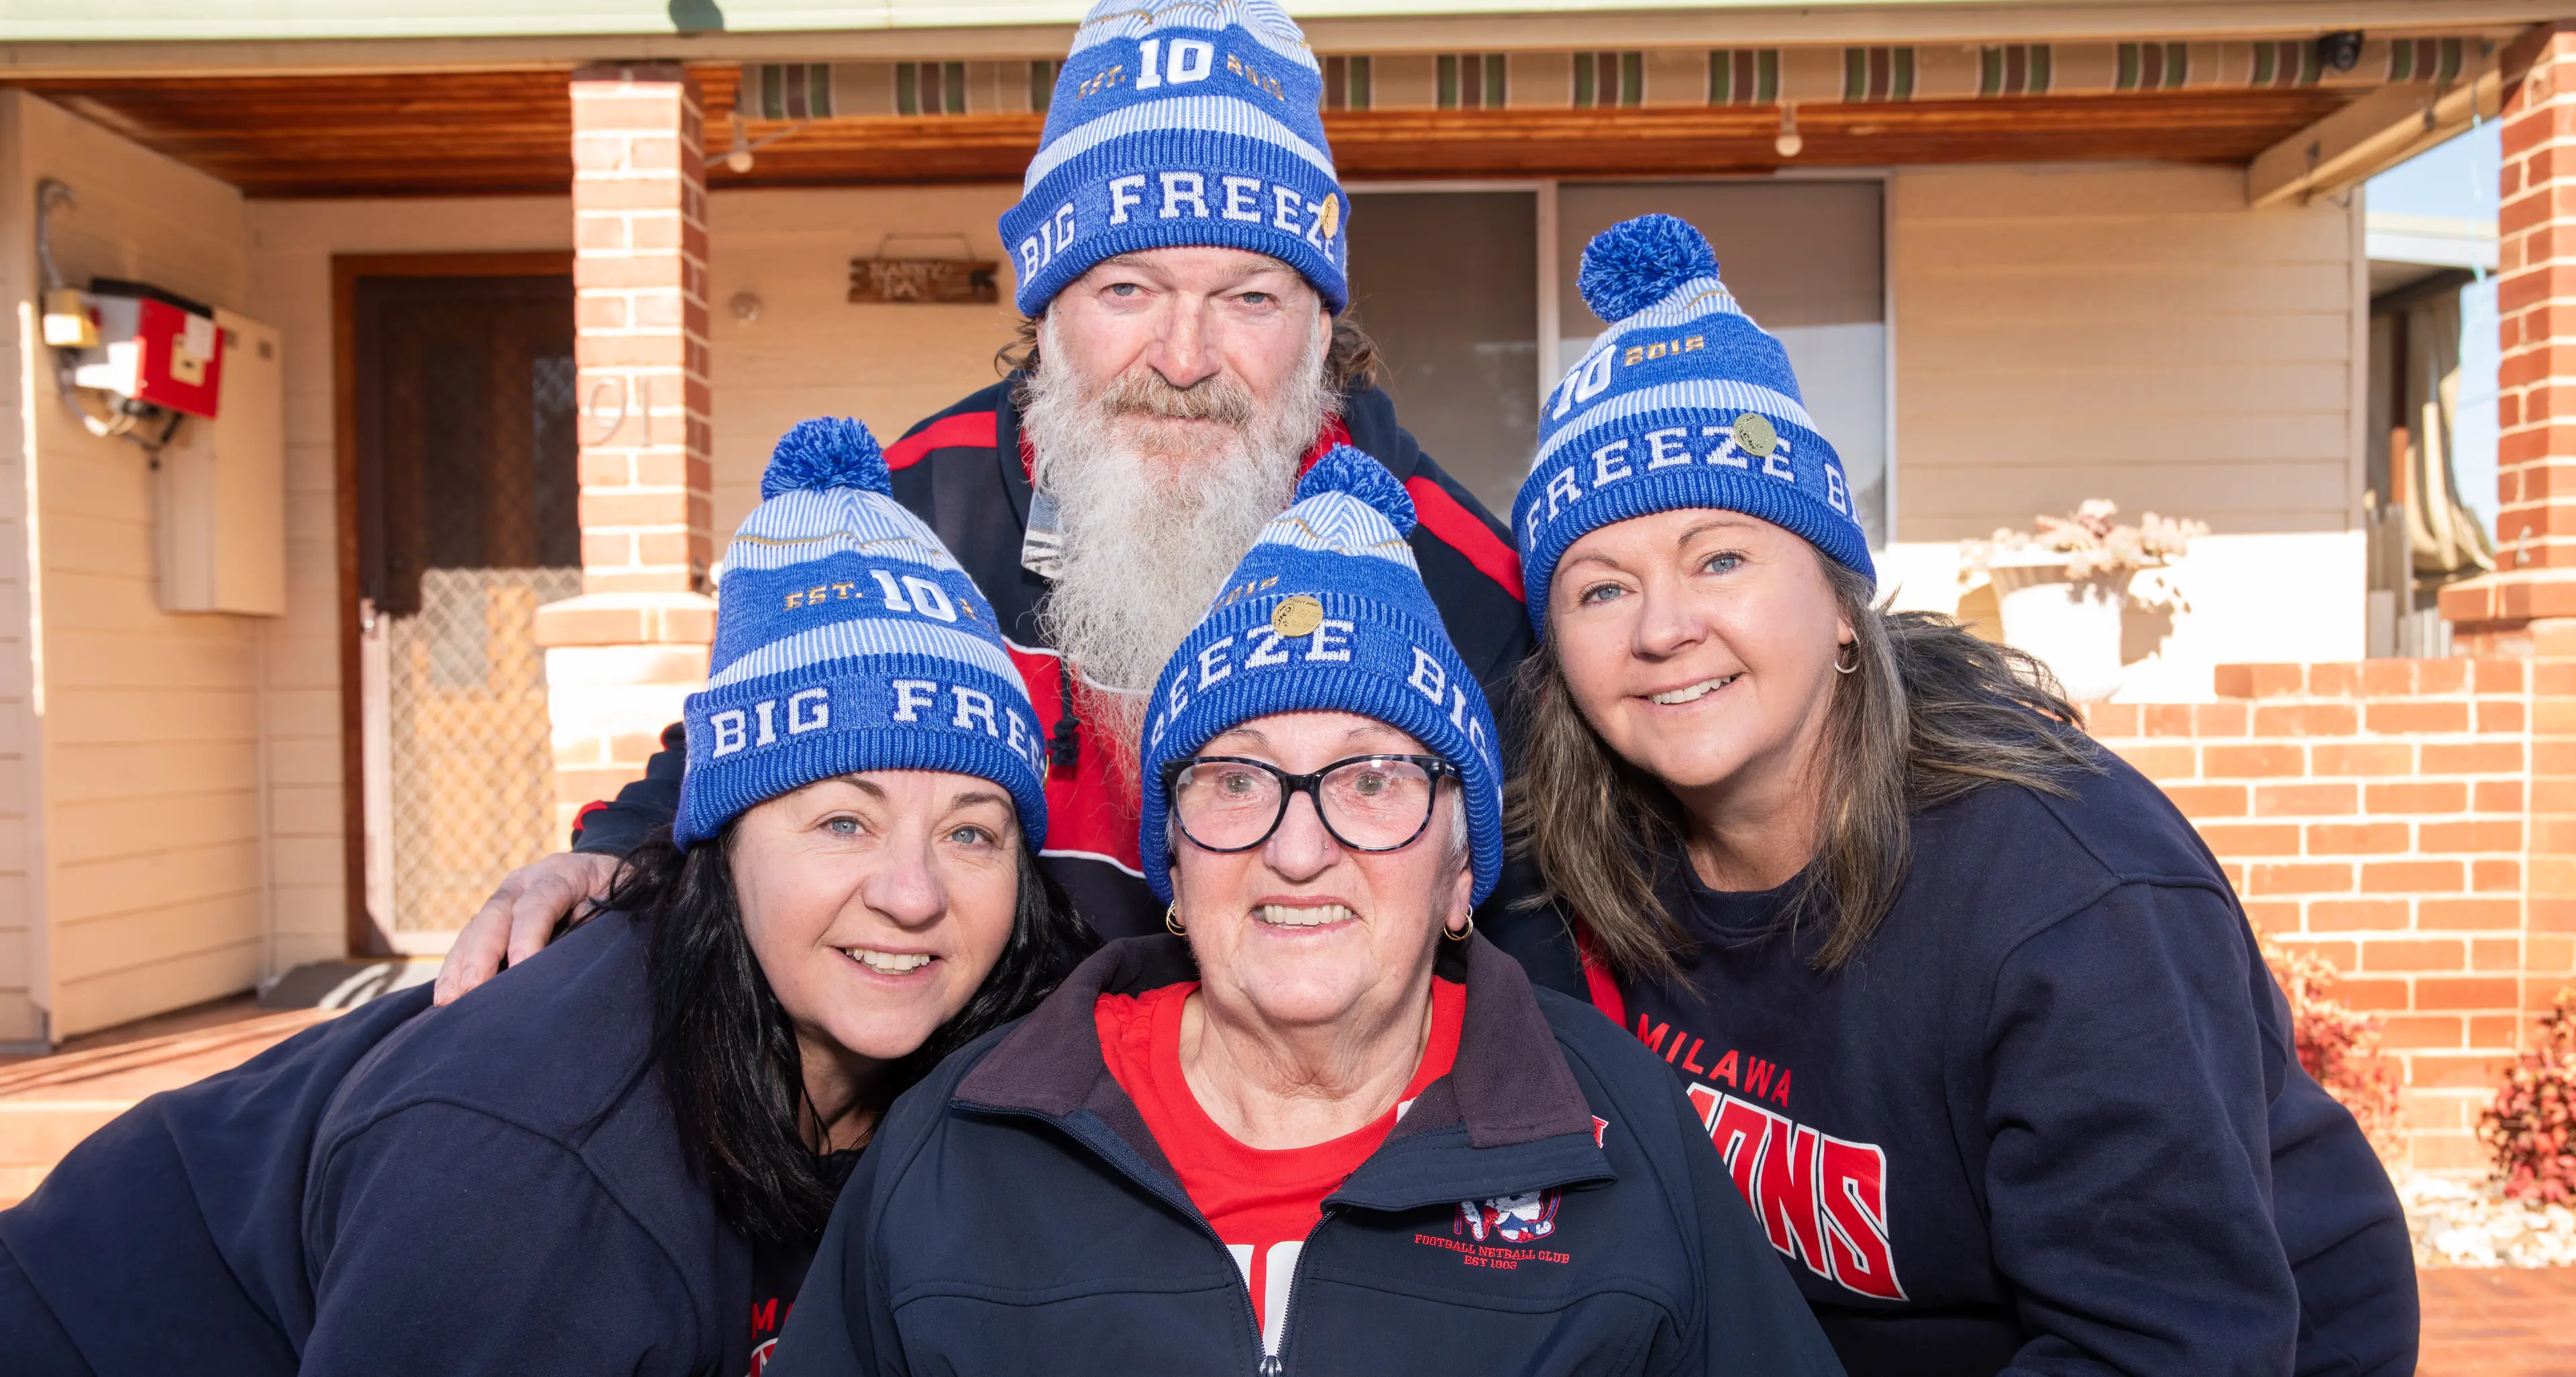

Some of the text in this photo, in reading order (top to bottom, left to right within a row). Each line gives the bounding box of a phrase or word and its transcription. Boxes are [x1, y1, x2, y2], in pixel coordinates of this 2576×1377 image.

[1075, 65, 1125, 101] EST.
[1136, 39, 1214, 91] 10
[1020, 203, 1075, 287] BIG
[584, 376, 653, 448] 91
[1552, 335, 1704, 421] 10 2015
[1525, 427, 1794, 552] FREEZE
[782, 582, 863, 611] EST.
[869, 569, 957, 623] 10
[710, 687, 830, 759] BIG
[1637, 1013, 1792, 1108] MILAWA
[1415, 1234, 1570, 1264] FOOTBALL NETBALL CLUB
[1464, 1254, 1488, 1267] EST
